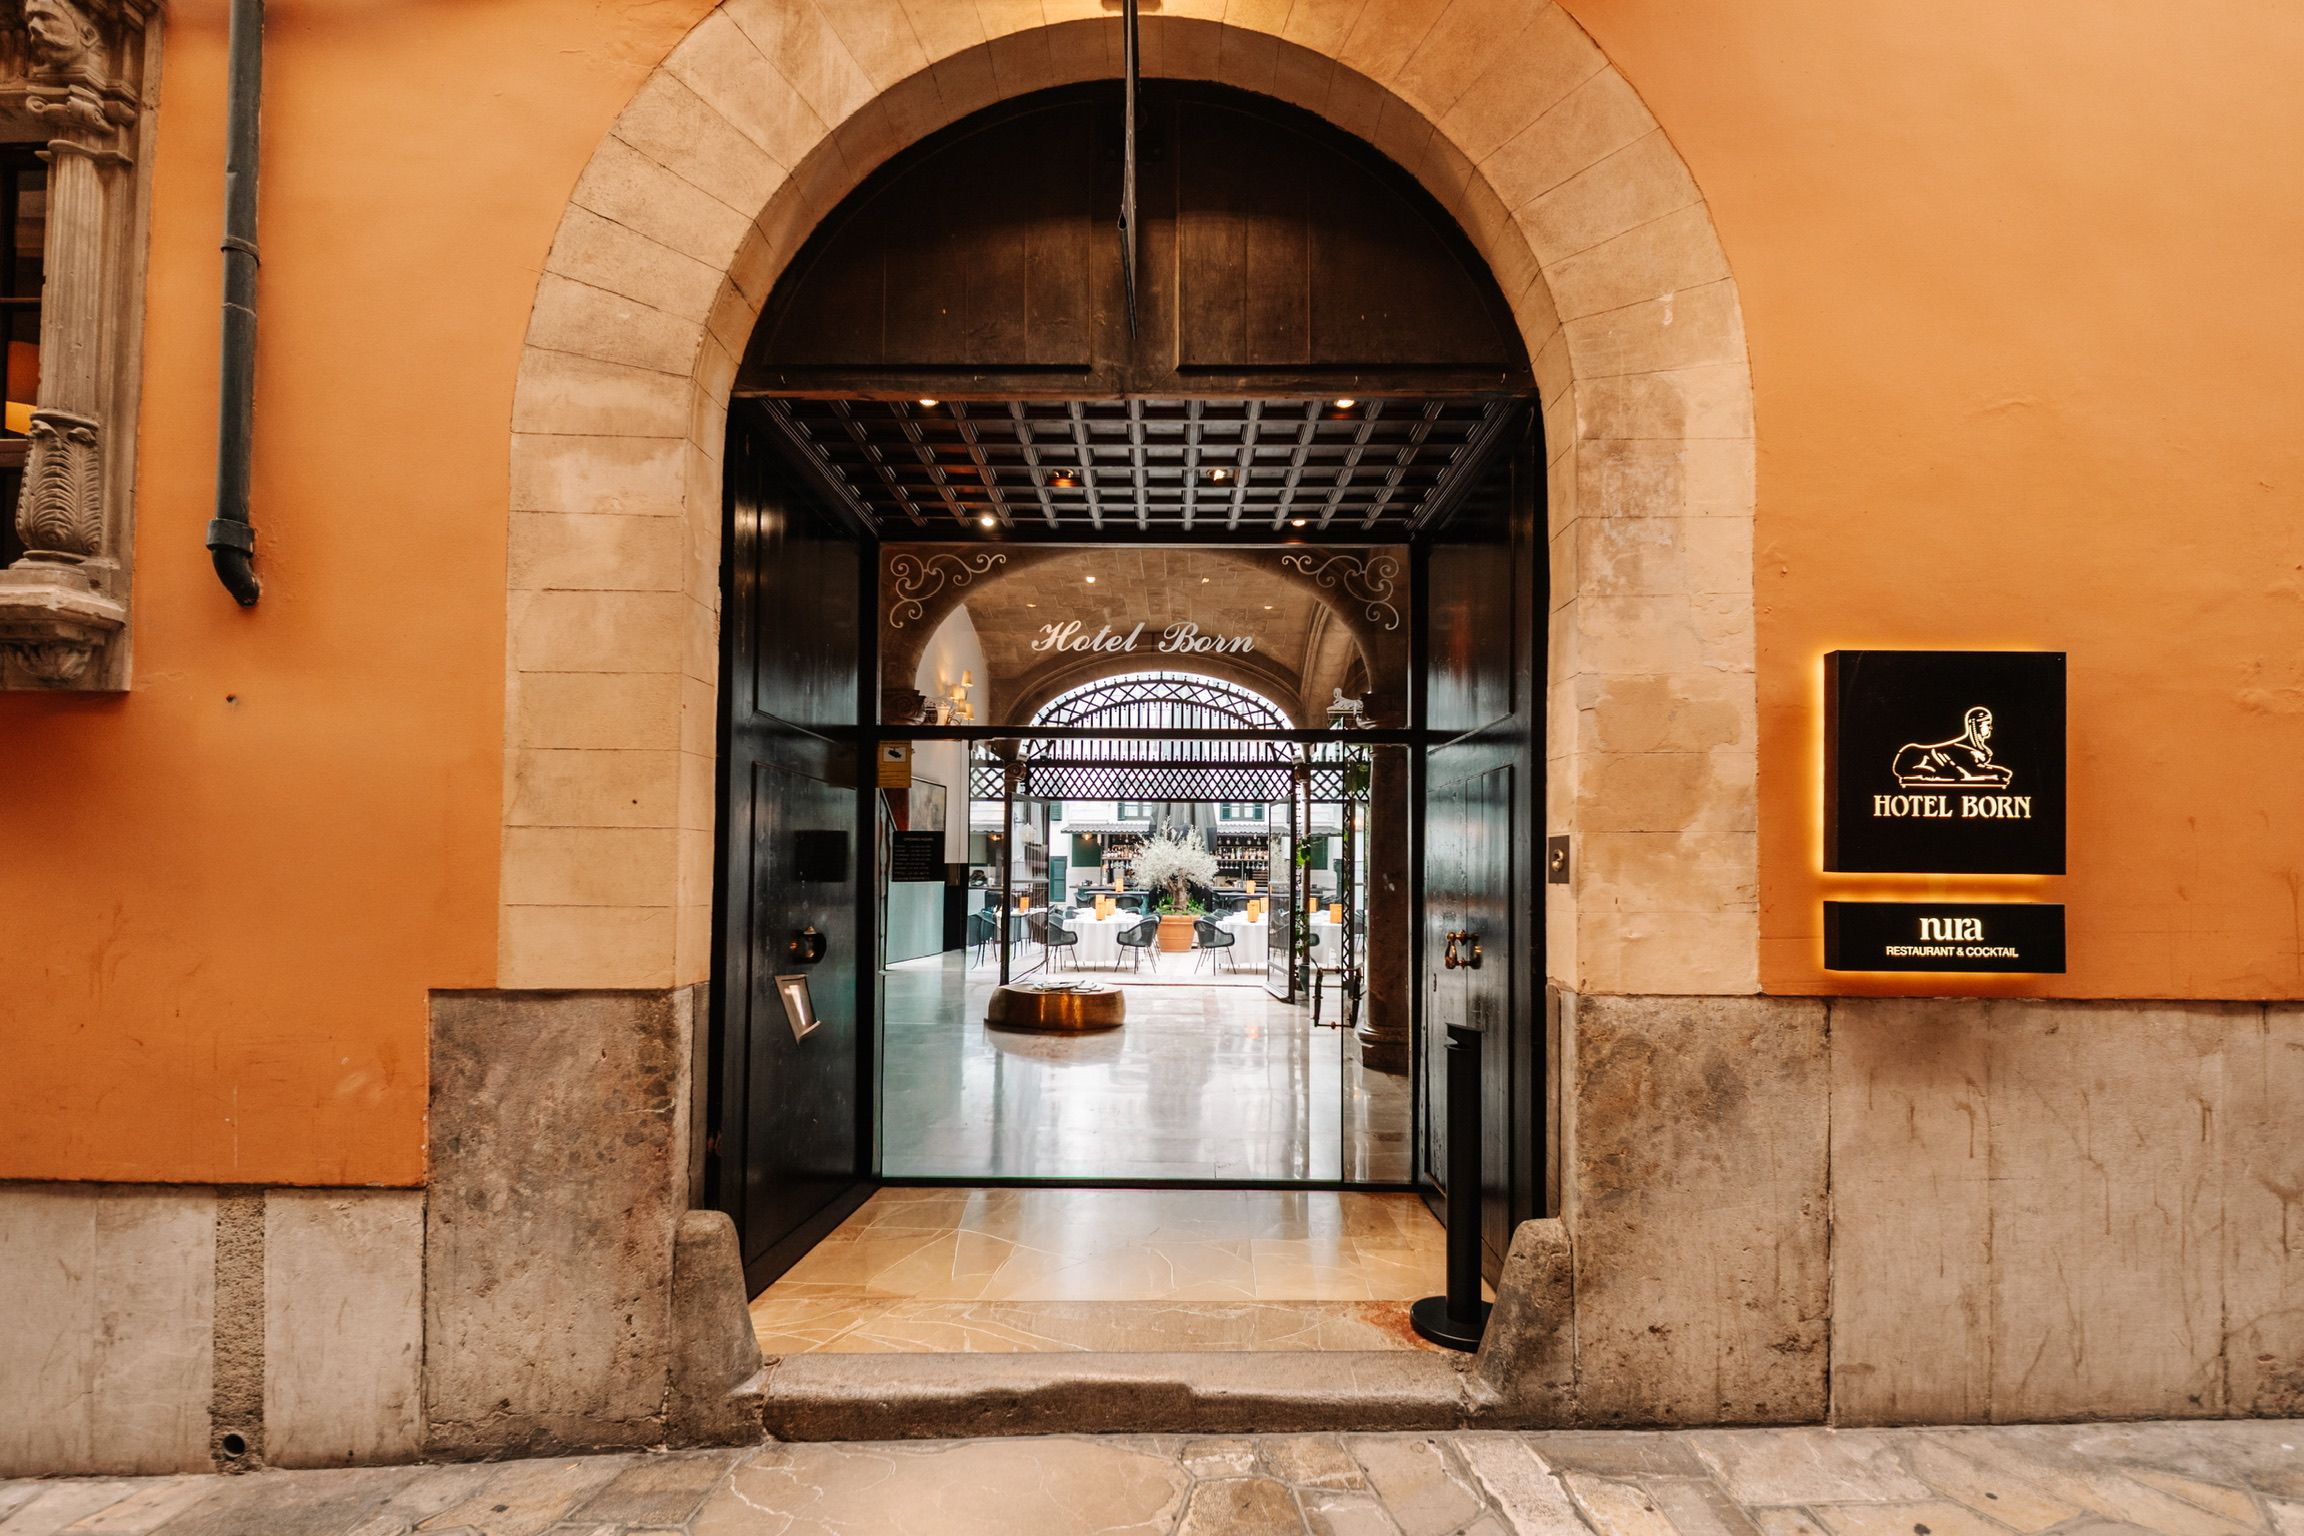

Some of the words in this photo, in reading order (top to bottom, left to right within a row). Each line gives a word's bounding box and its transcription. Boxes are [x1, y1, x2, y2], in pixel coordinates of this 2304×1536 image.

[1031, 620, 1145, 652] Hotel
[1158, 621, 1255, 653] Born
[1873, 794, 1953, 818] HOTEL
[1961, 795, 2032, 819] BORN
[1919, 917, 1985, 942] nura
[1886, 945, 1955, 957] RESTAURANT
[1956, 946, 1964, 957] &
[1965, 946, 2019, 958] COCKTAIL
